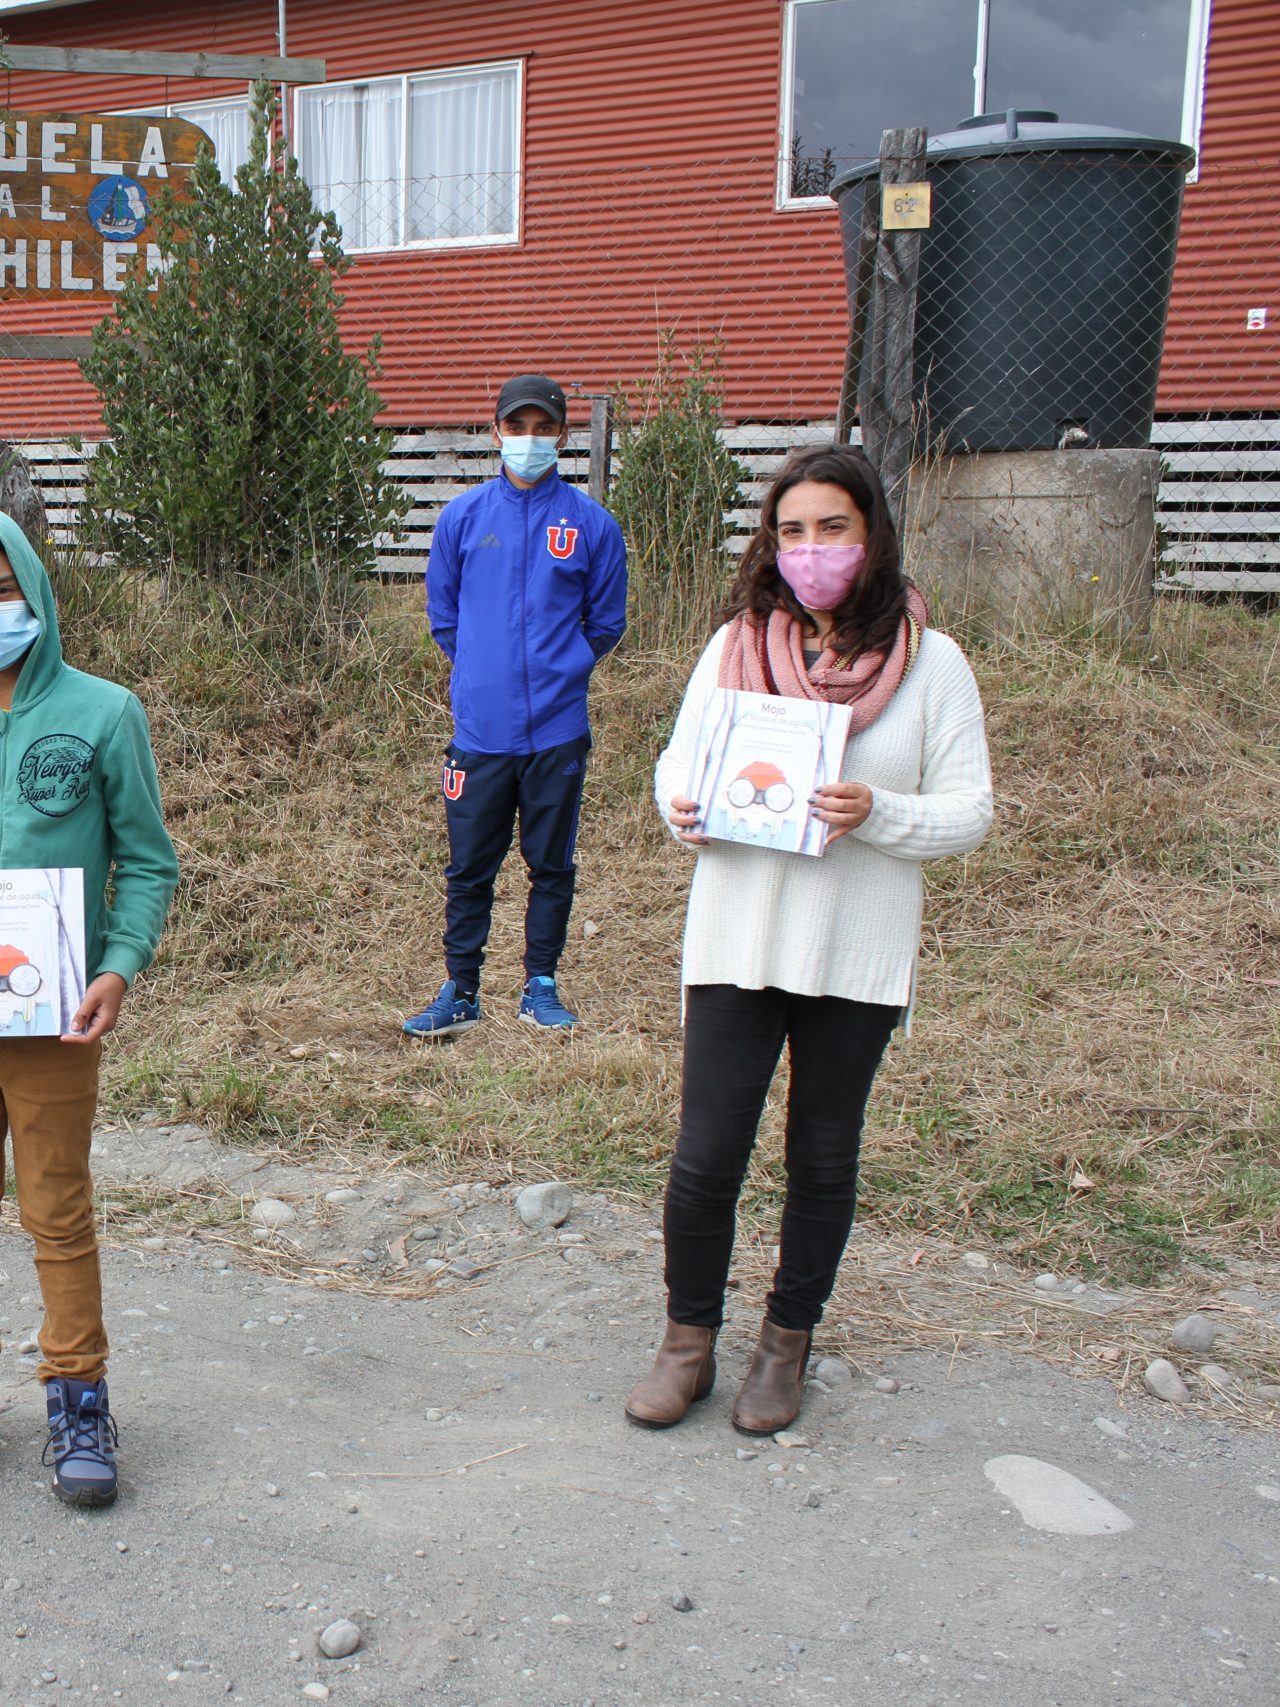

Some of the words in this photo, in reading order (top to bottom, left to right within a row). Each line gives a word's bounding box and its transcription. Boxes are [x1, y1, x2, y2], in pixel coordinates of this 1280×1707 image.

[547, 526, 578, 559] U
[761, 702, 786, 716] Mojo
[443, 766, 466, 800] U
[6, 892, 17, 901] de
